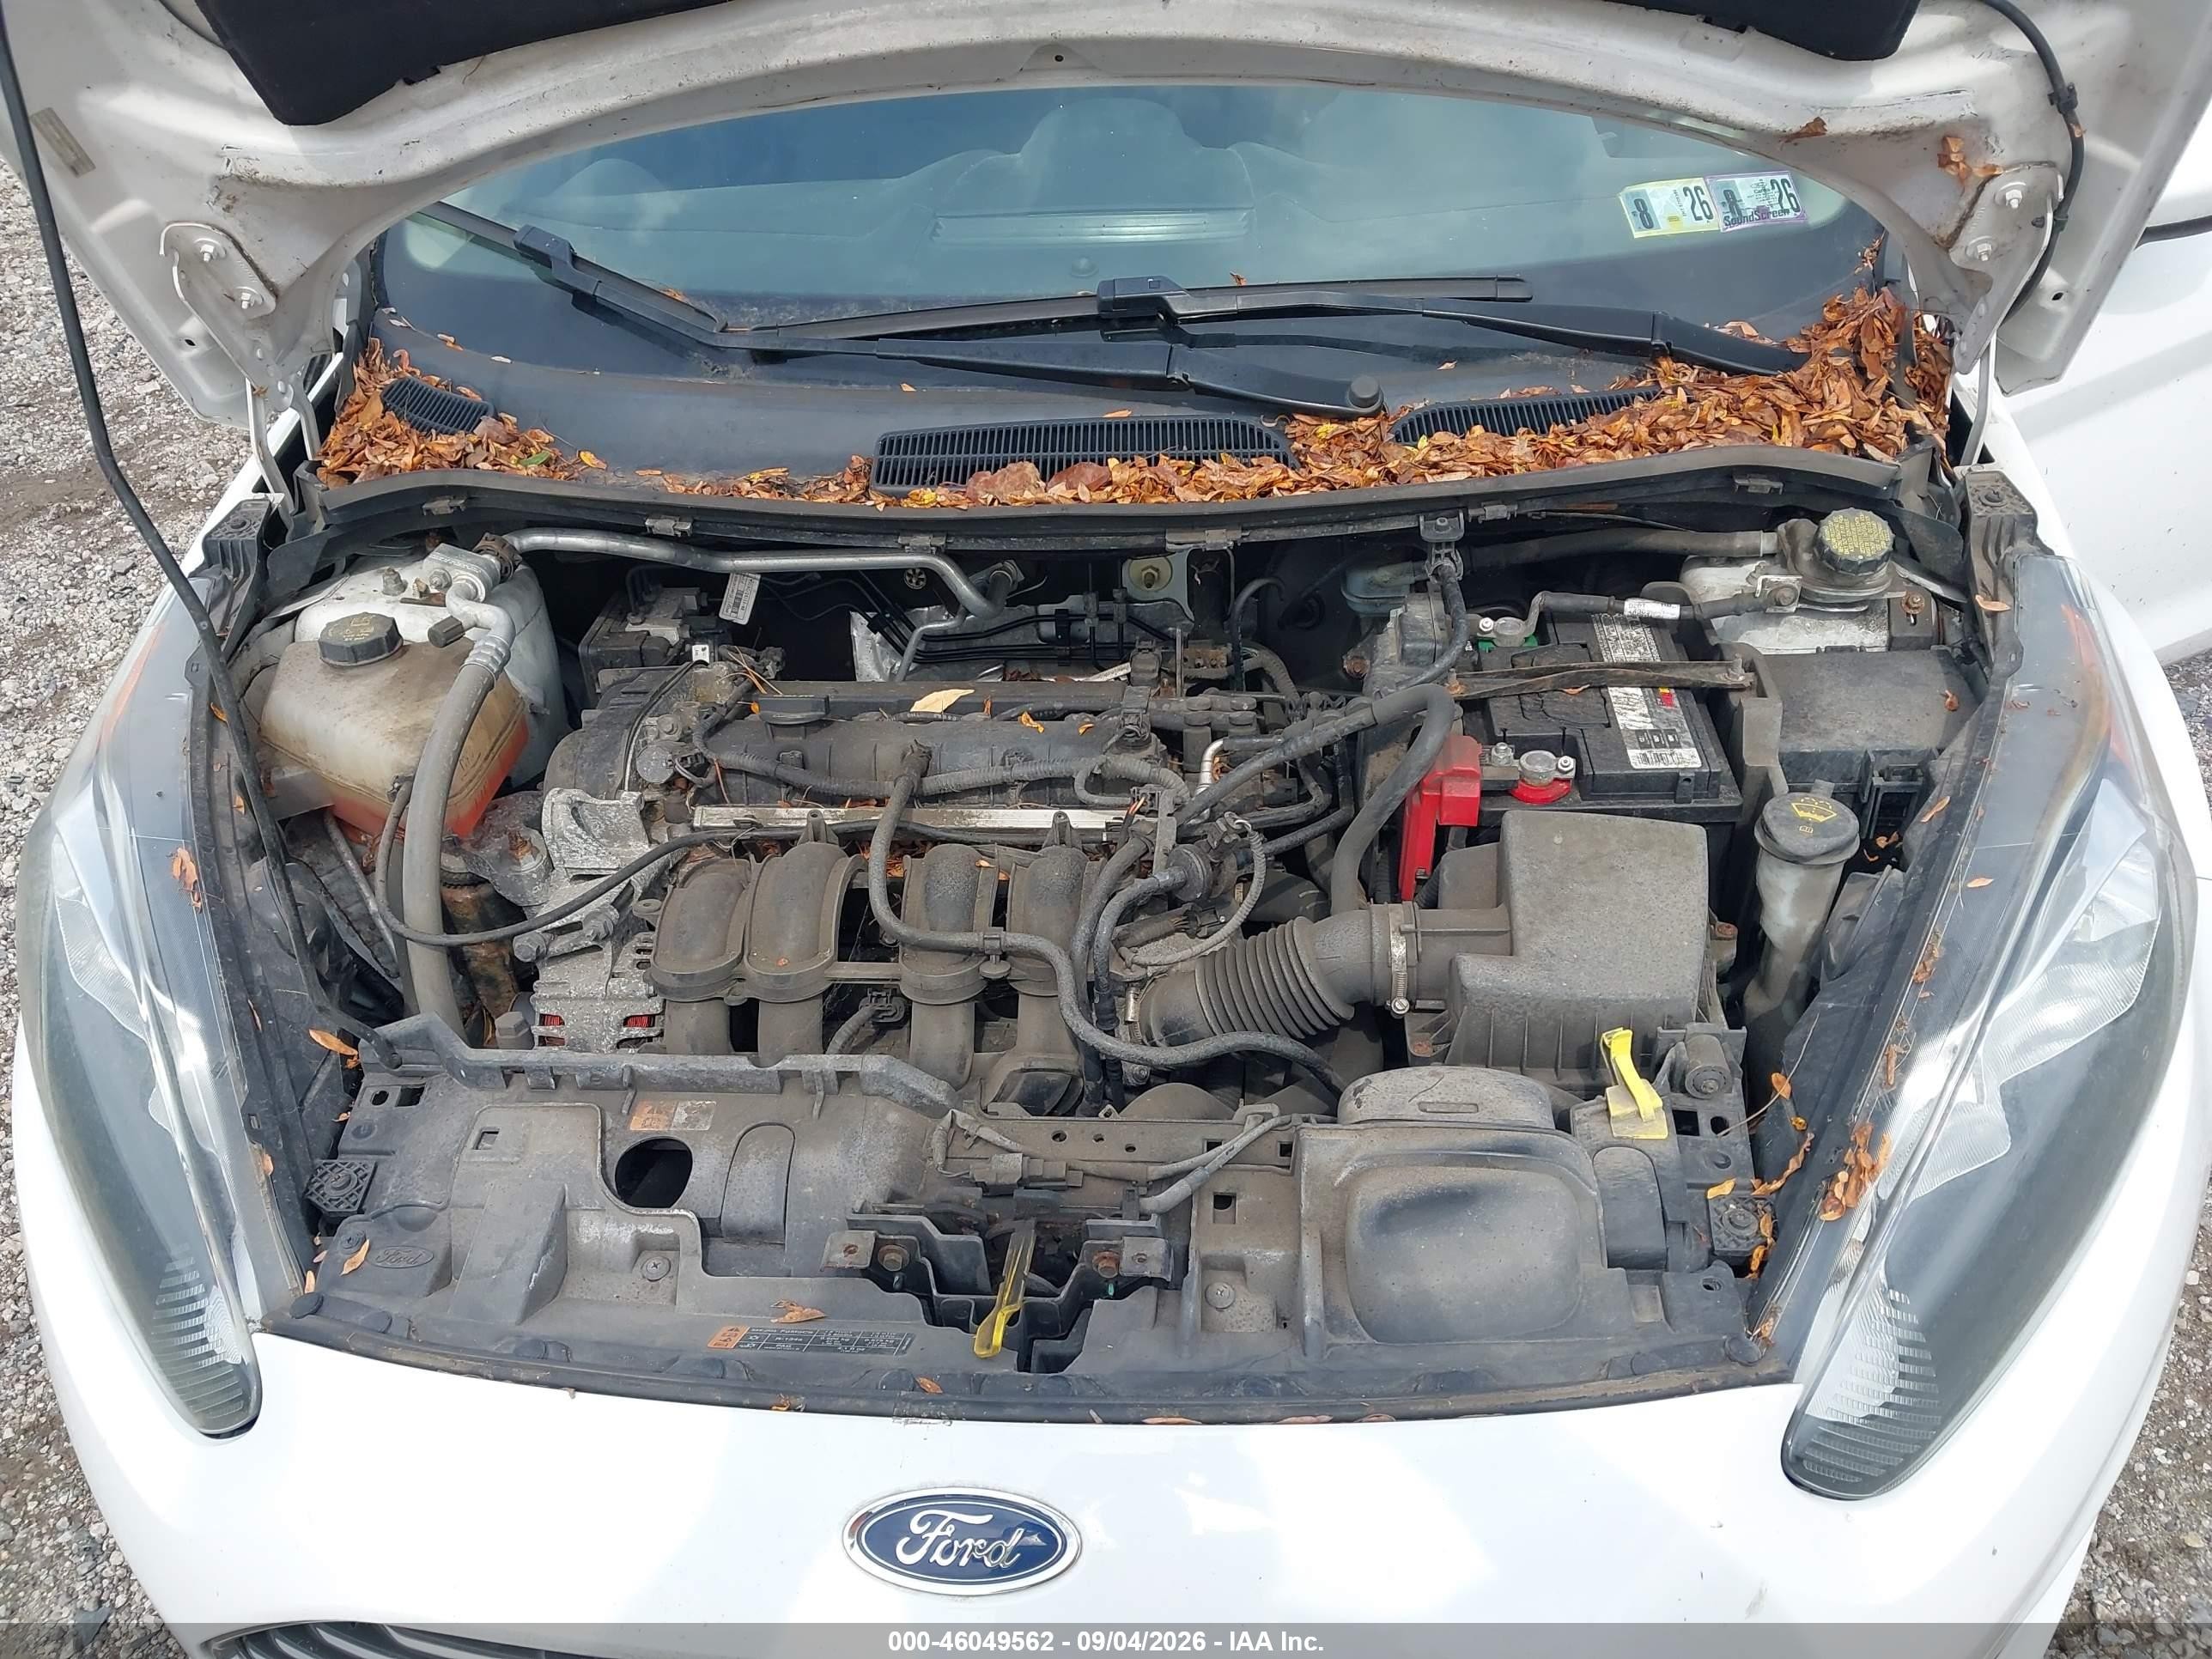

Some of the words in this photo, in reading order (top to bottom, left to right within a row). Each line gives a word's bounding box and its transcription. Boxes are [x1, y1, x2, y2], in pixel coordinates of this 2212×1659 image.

[1633, 198, 1654, 228] 8
[1683, 185, 1713, 221] 26
[1770, 178, 1801, 212] 26
[1723, 208, 1790, 227] SoundScreen
[375, 1249, 422, 1265] Ford
[895, 1509, 1021, 1570] Ford
